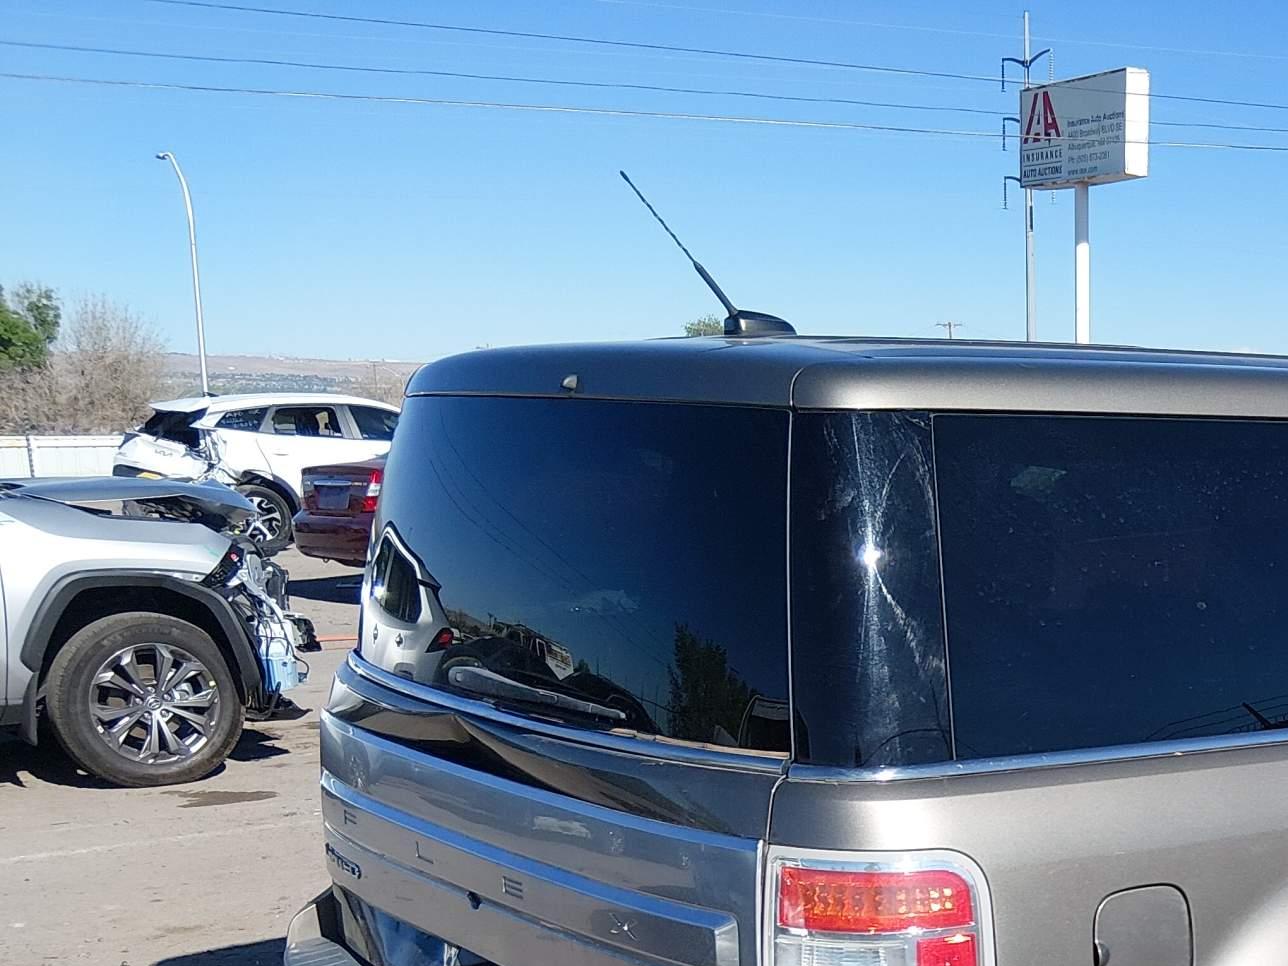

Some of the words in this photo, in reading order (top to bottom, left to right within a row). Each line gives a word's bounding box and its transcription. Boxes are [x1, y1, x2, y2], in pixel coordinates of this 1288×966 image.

[1023, 149, 1063, 163] INSURANCE
[1023, 168, 1037, 178] AUTO
[1038, 165, 1062, 177] AUCTIONS
